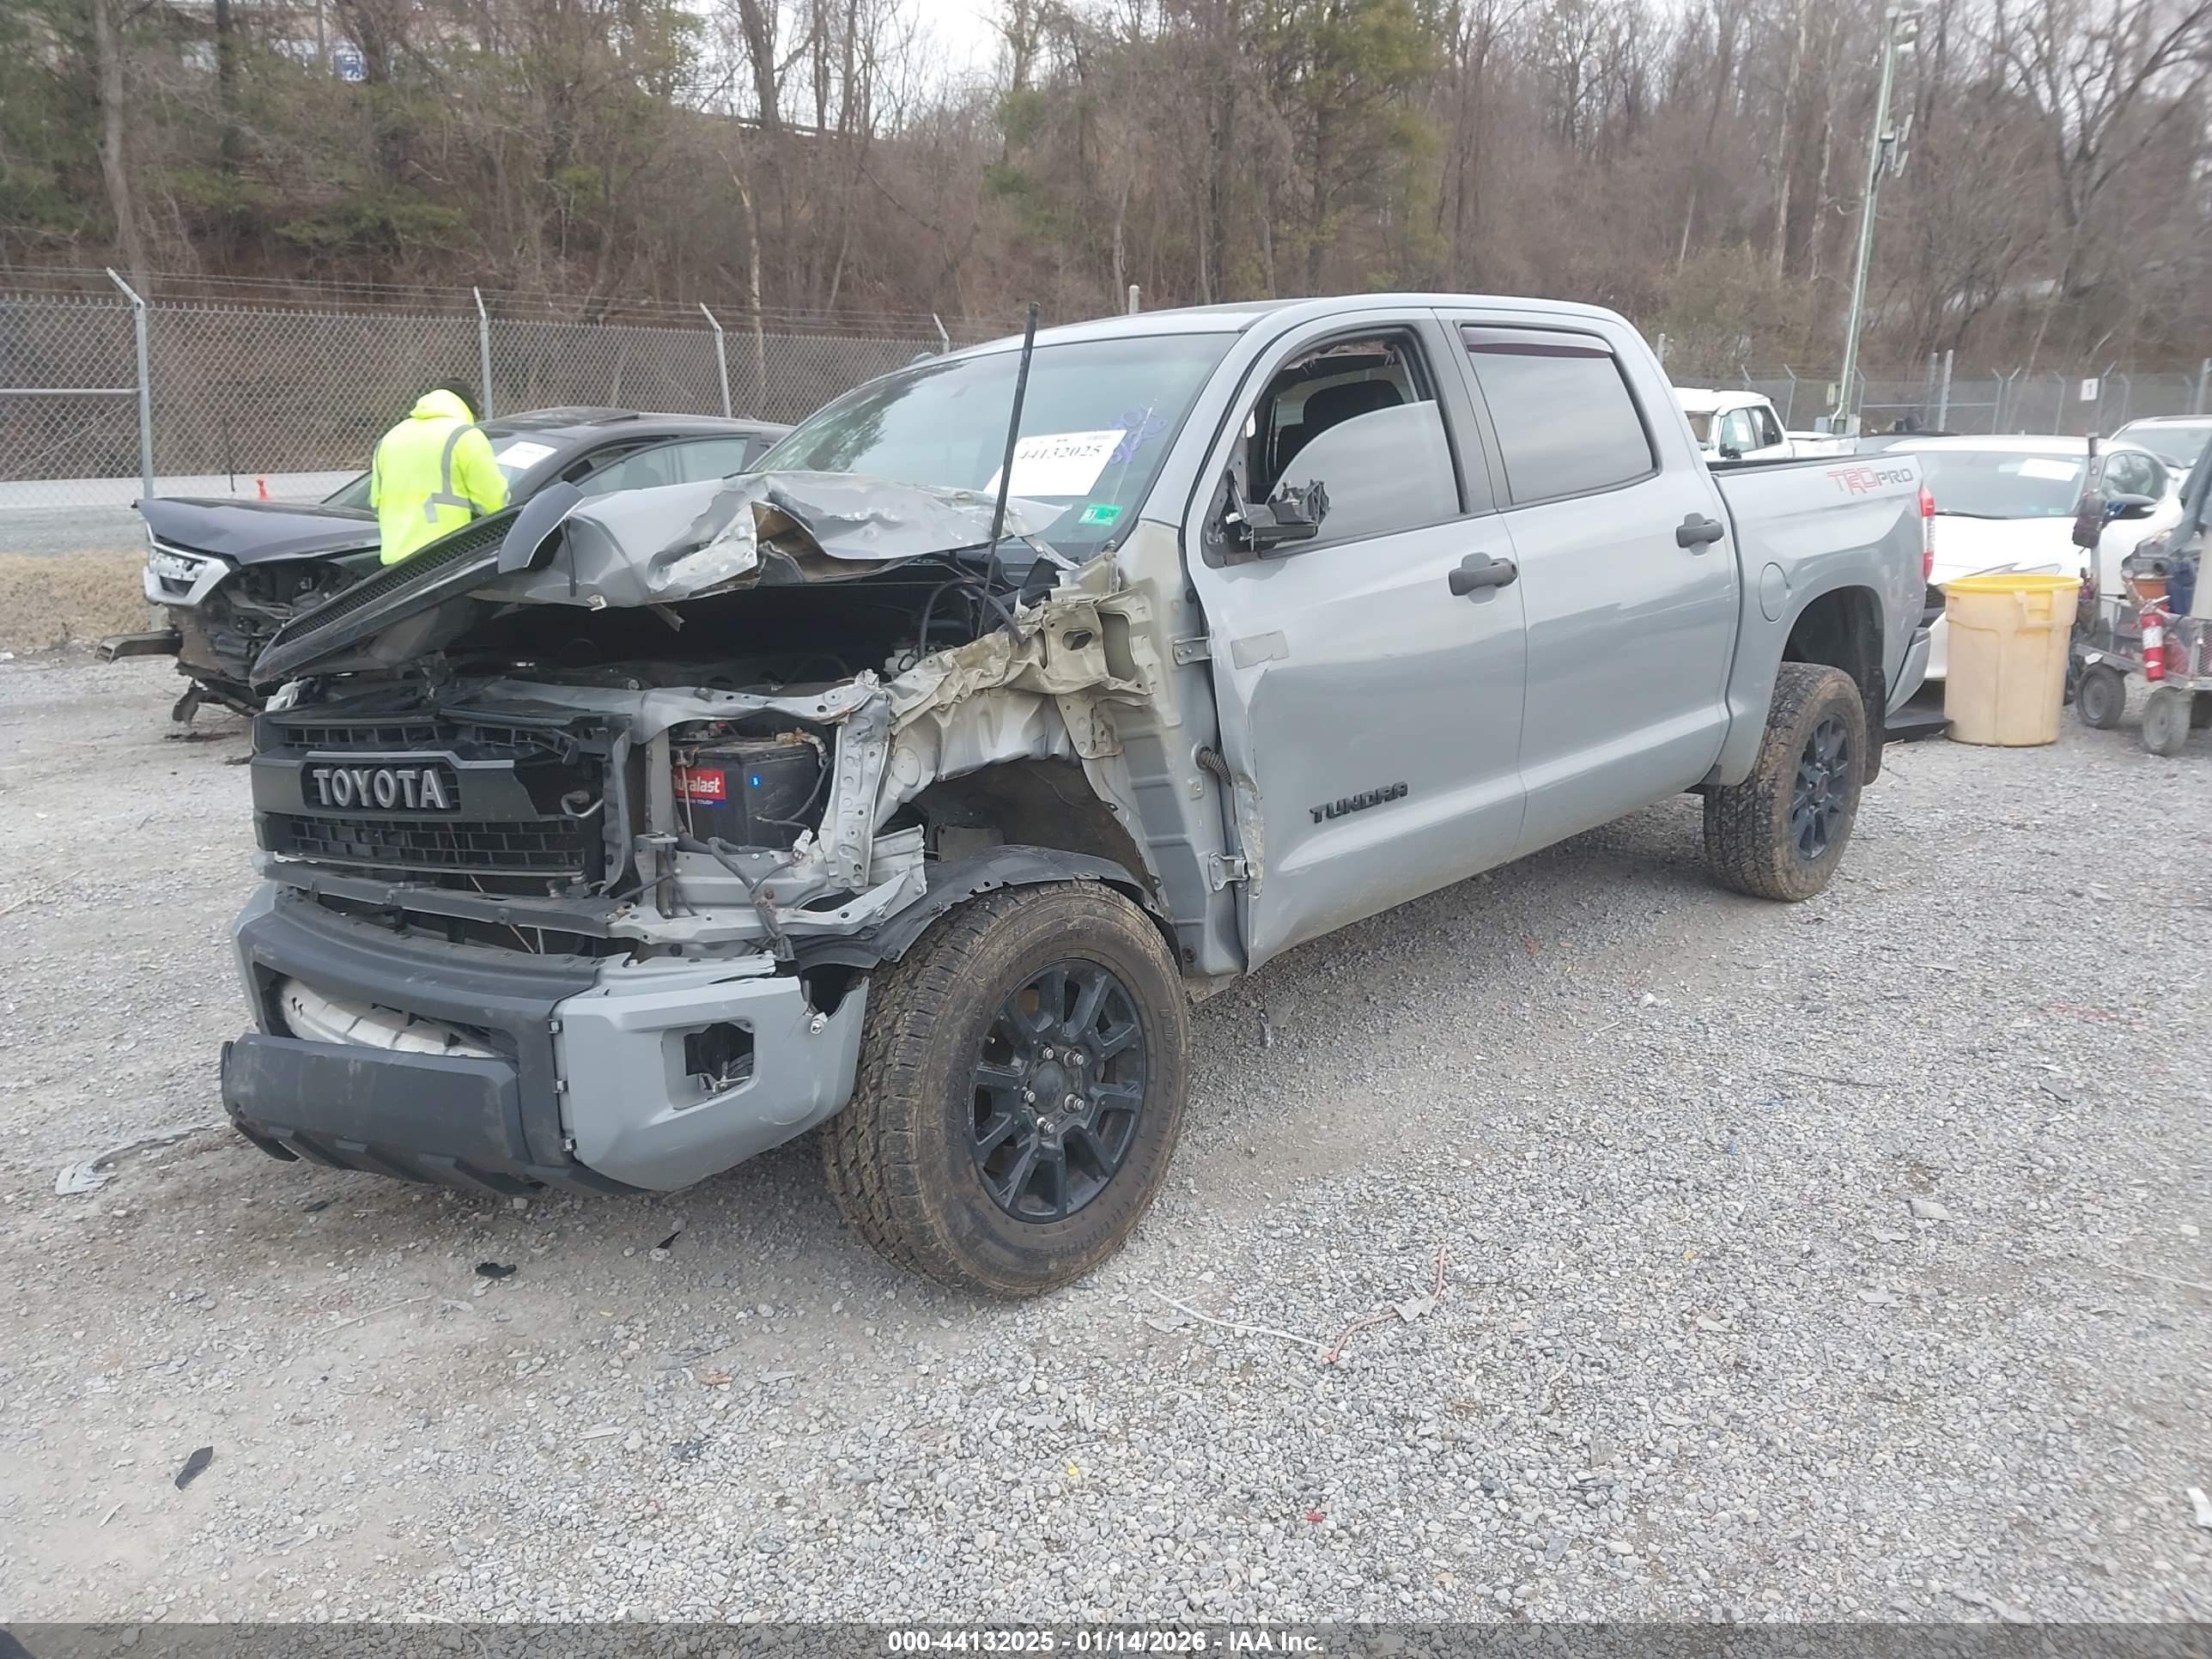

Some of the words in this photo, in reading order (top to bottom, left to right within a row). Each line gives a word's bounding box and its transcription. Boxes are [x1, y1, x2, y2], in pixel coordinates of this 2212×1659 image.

[1018, 445, 1104, 459] 44132025
[1826, 466, 1878, 495] TRD
[1875, 468, 1915, 486] PRO
[313, 769, 451, 809] TOYOTA
[1310, 781, 1408, 823] TUNDRA
